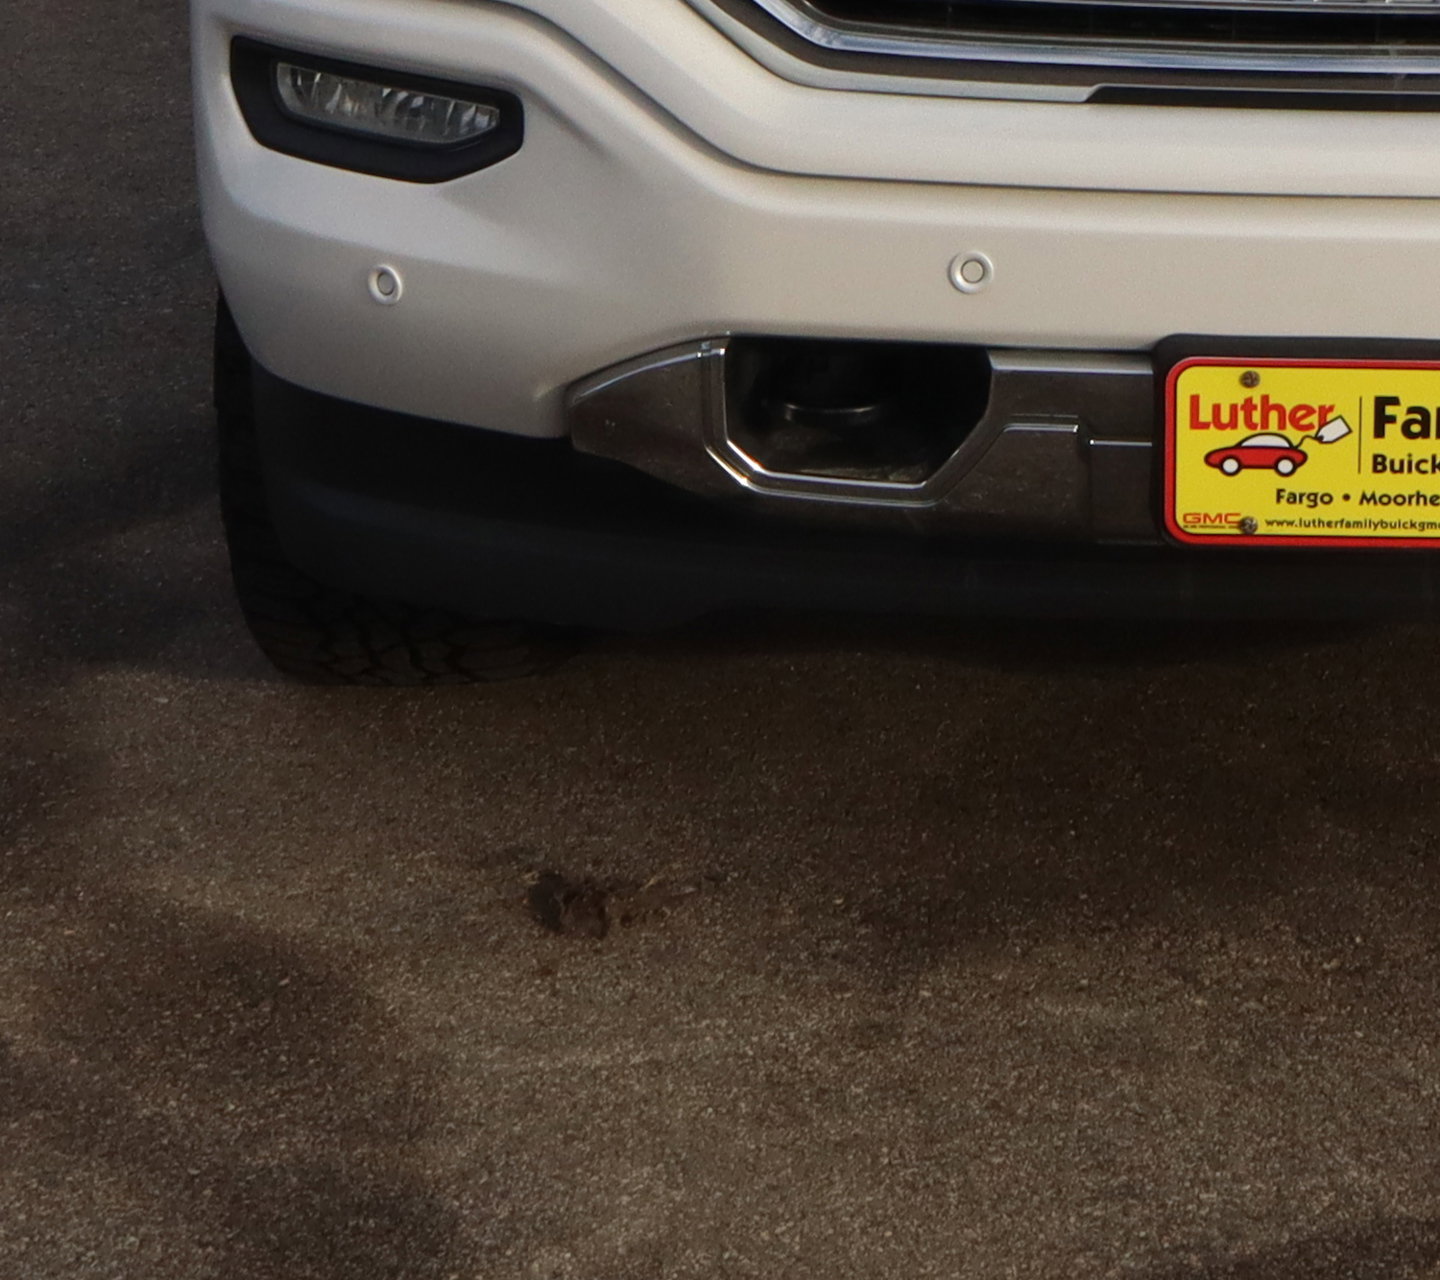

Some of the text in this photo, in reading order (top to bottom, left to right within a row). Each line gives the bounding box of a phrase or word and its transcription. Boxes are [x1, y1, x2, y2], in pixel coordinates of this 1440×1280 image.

[1188, 394, 1335, 432] Luther
[1275, 488, 1334, 512] Fargo
[1183, 512, 1242, 524] GMC
